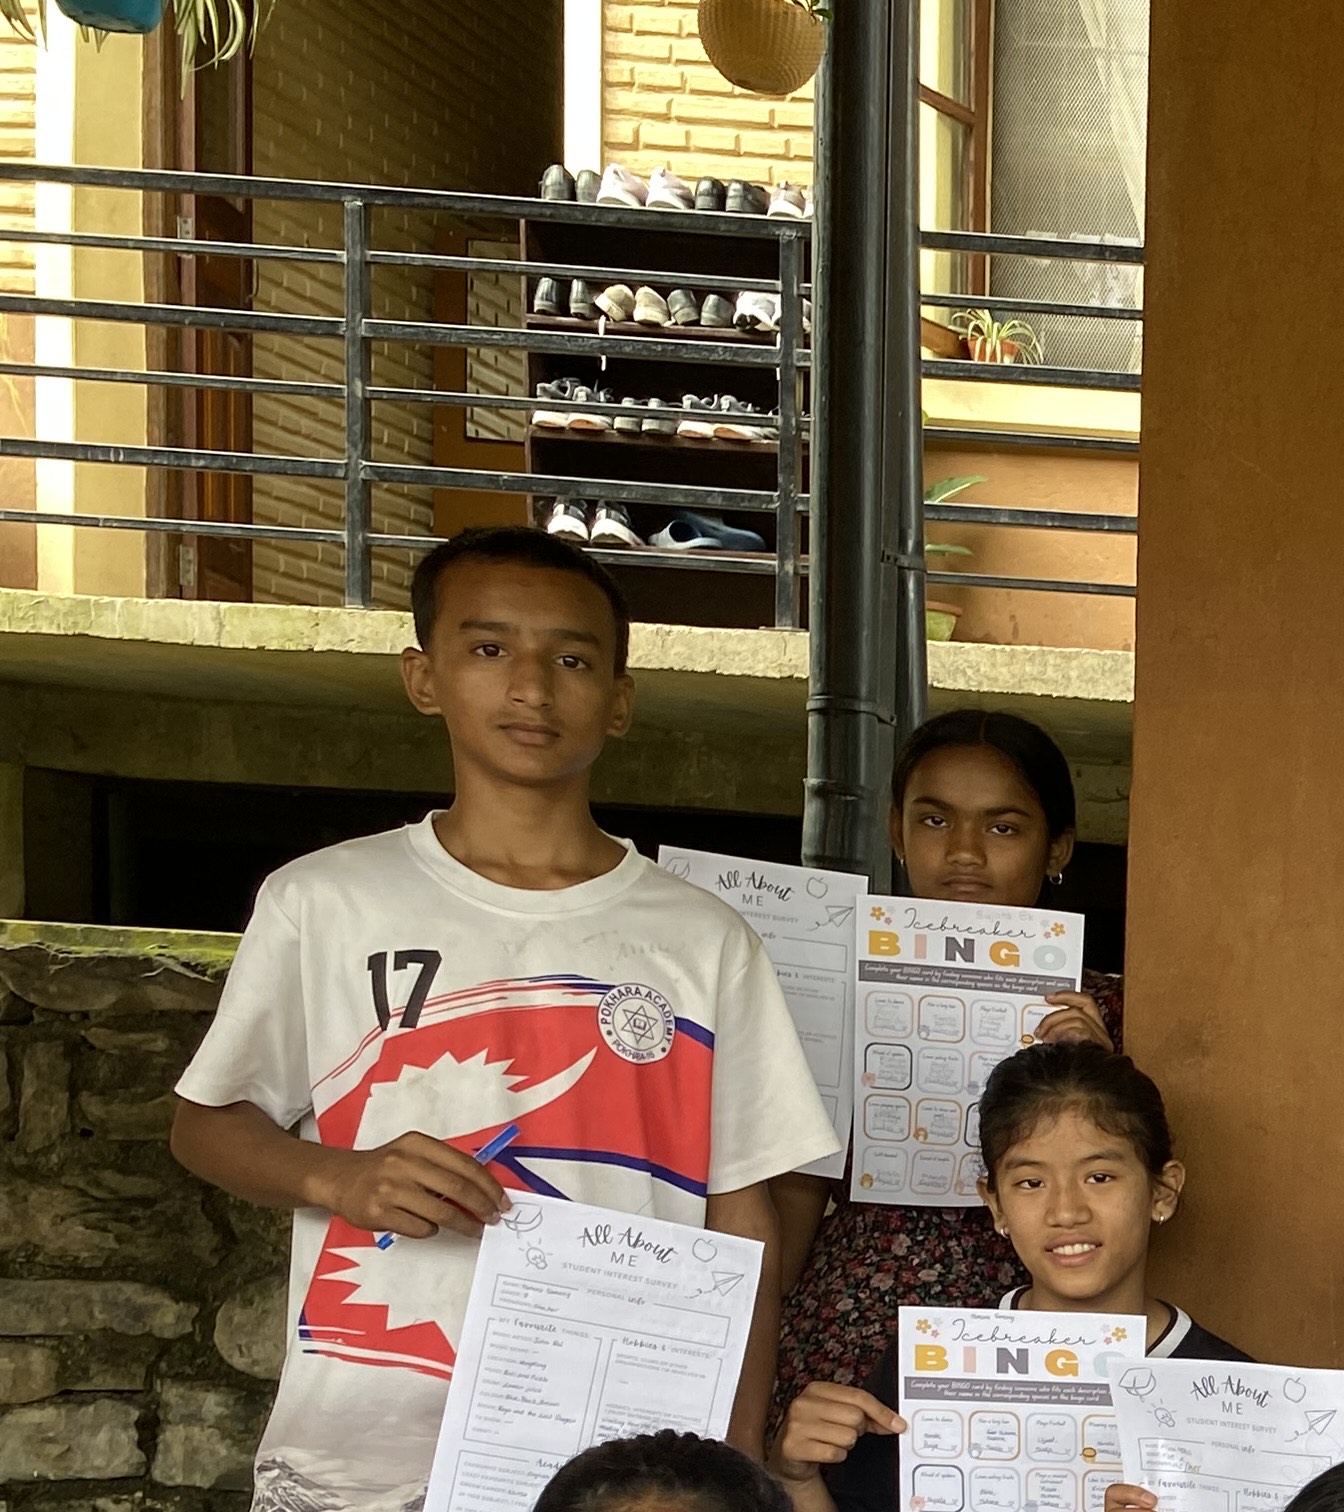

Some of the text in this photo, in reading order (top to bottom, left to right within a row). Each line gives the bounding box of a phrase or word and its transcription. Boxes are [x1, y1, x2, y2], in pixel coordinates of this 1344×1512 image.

[715, 870, 795, 903] All About
[742, 894, 764, 907] ME
[904, 907, 1037, 939] Icebreaker
[868, 930, 1067, 971] BINGO
[367, 949, 442, 1032] 17
[601, 986, 673, 1045] POKHARA ACADEMY
[577, 1224, 679, 1264] All About
[610, 1251, 639, 1268] ME
[562, 1262, 679, 1290] STUDENT INTEREST SURVEY
[951, 1318, 1097, 1346] Icebreaker
[1190, 1374, 1273, 1410] All About
[1222, 1401, 1243, 1415] ME
